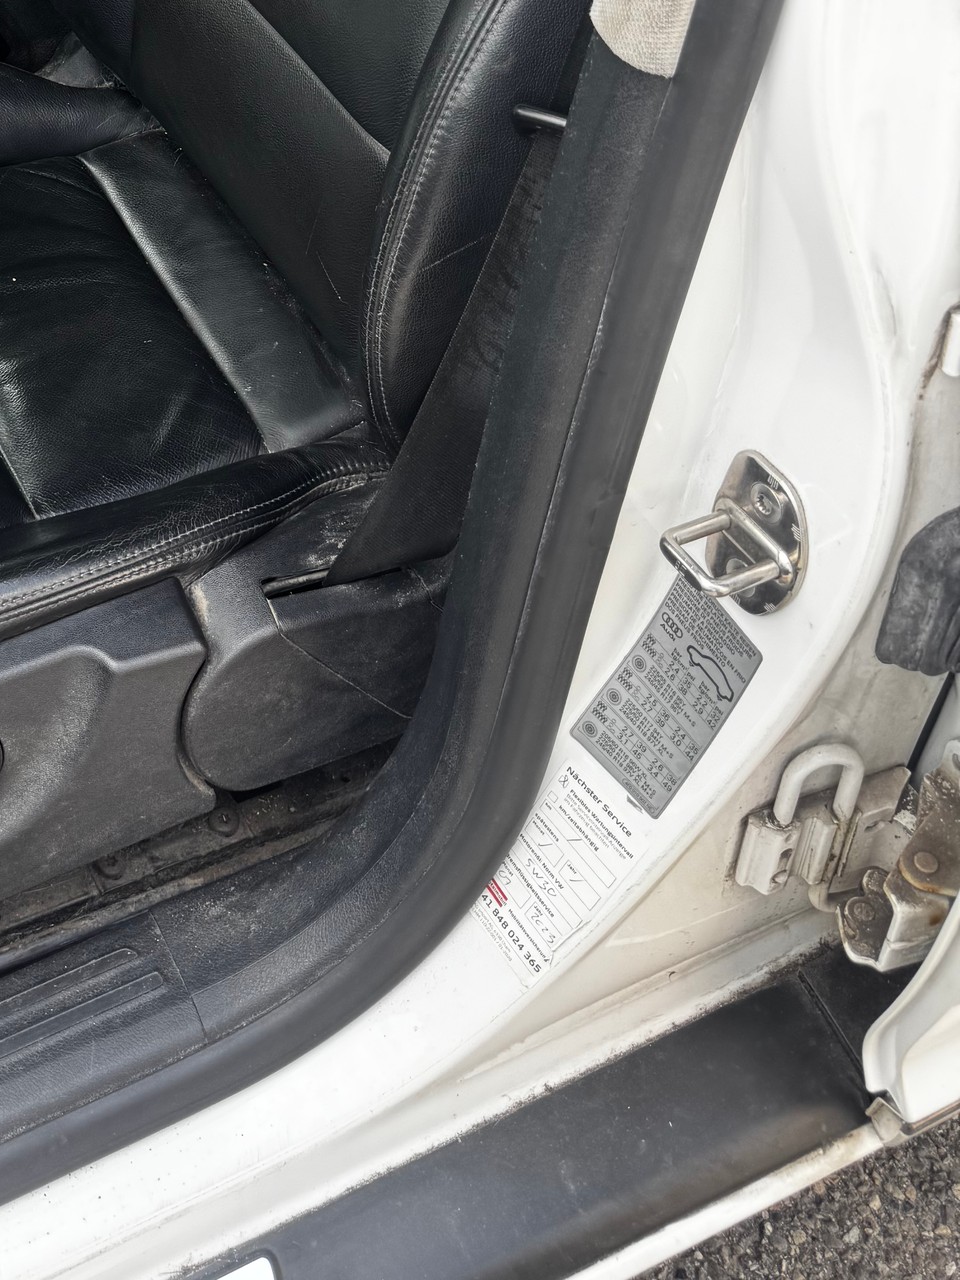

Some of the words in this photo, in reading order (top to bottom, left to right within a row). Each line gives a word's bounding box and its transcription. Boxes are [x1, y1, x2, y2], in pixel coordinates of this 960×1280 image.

[664, 601, 676, 615] DOS
[674, 613, 691, 633] PNEUS
[672, 586, 701, 621] PNEUMATICI
[703, 624, 724, 649] FREDDO
[674, 581, 701, 613] PRESSIONE
[677, 577, 701, 605] PRESSION
[699, 604, 710, 617] DES
[709, 615, 726, 636] PNEUS
[658, 620, 677, 642] Audi
[687, 620, 696, 631] DE
[689, 614, 697, 624] DE
[695, 622, 728, 662] NEUMATICOS
[726, 659, 735, 670] EN
[726, 628, 753, 660] PRESSURE
[738, 635, 756, 656] REIFEN
[673, 647, 682, 658] bar
[700, 680, 710, 692] bar
[677, 682, 688, 696] 38
[705, 717, 716, 730] 42
[681, 676, 692, 689] 35
[709, 710, 721, 723] 32
[686, 670, 695, 682] psi
[714, 705, 723, 716] psi
[654, 715, 665, 728] 39
[684, 748, 694, 761] 44
[656, 746, 665, 757] XL
[659, 708, 670, 722] 36
[688, 742, 699, 755] 35
[631, 747, 642, 760] 45
[661, 779, 672, 793] 49
[632, 776, 641, 786] XL
[635, 772, 644, 782] XL
[636, 740, 647, 754] 39
[666, 773, 677, 786] 38
[640, 770, 648, 780] XL
[566, 764, 604, 805] Nächster
[601, 803, 632, 838] Service
[569, 788, 591, 813] Flexibles
[589, 811, 633, 859] Wartungsintervall
[531, 819, 545, 836] Monat
[566, 862, 577, 875] Jahr
[533, 811, 560, 842] spätestens
[558, 804, 599, 852] km/zeitabhängig
[540, 862, 556, 879] Norm
[553, 877, 564, 890] VW
[533, 903, 543, 916] Jahr
[491, 907, 509, 930] 848
[506, 929, 524, 951] 024
[523, 950, 542, 973] 365
